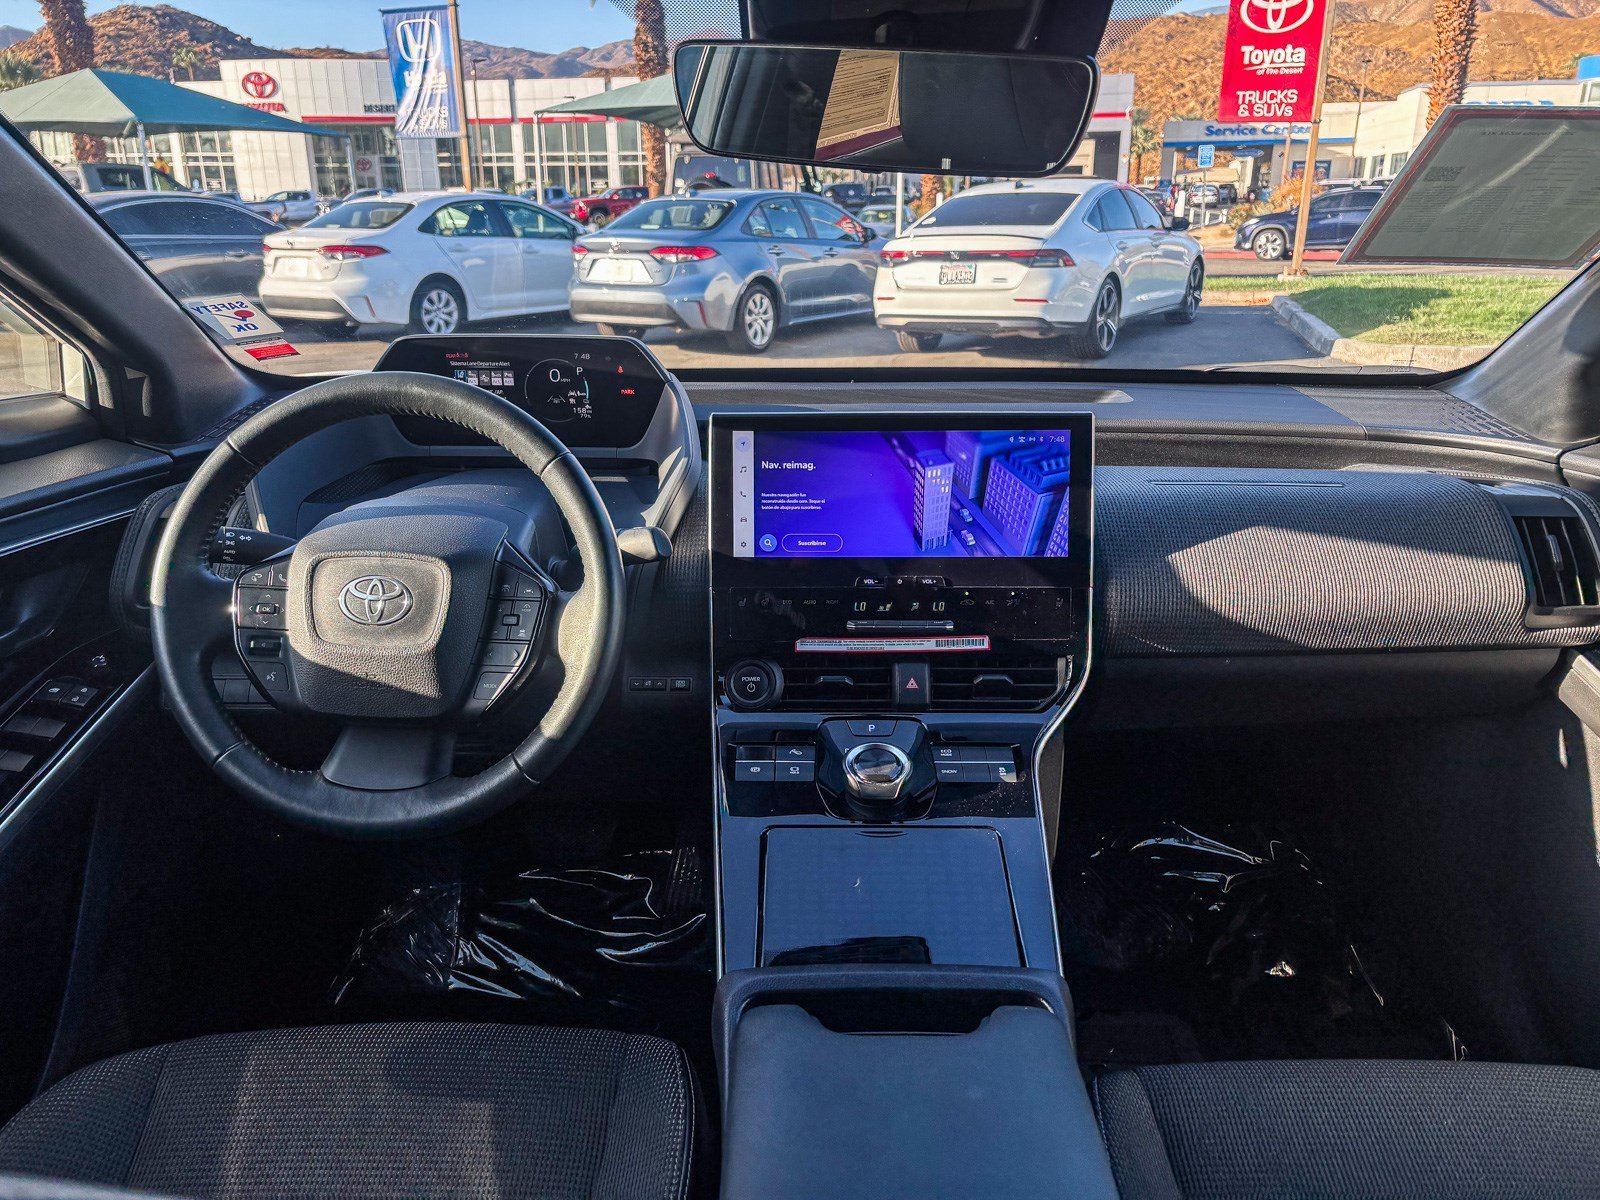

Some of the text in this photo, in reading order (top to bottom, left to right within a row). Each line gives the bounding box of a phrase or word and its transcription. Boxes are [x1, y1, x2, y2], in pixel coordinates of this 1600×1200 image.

[1241, 44, 1306, 67] Toyota
[1236, 89, 1298, 104] TRUCKS
[1238, 103, 1293, 117] & SUVs
[1205, 125, 1257, 136] Service
[549, 368, 561, 382] 0
[576, 367, 583, 375] P
[761, 461, 816, 471] Nav. reimag.
[854, 601, 867, 611] LO
[932, 601, 945, 611] LO
[868, 724, 875, 732] P
